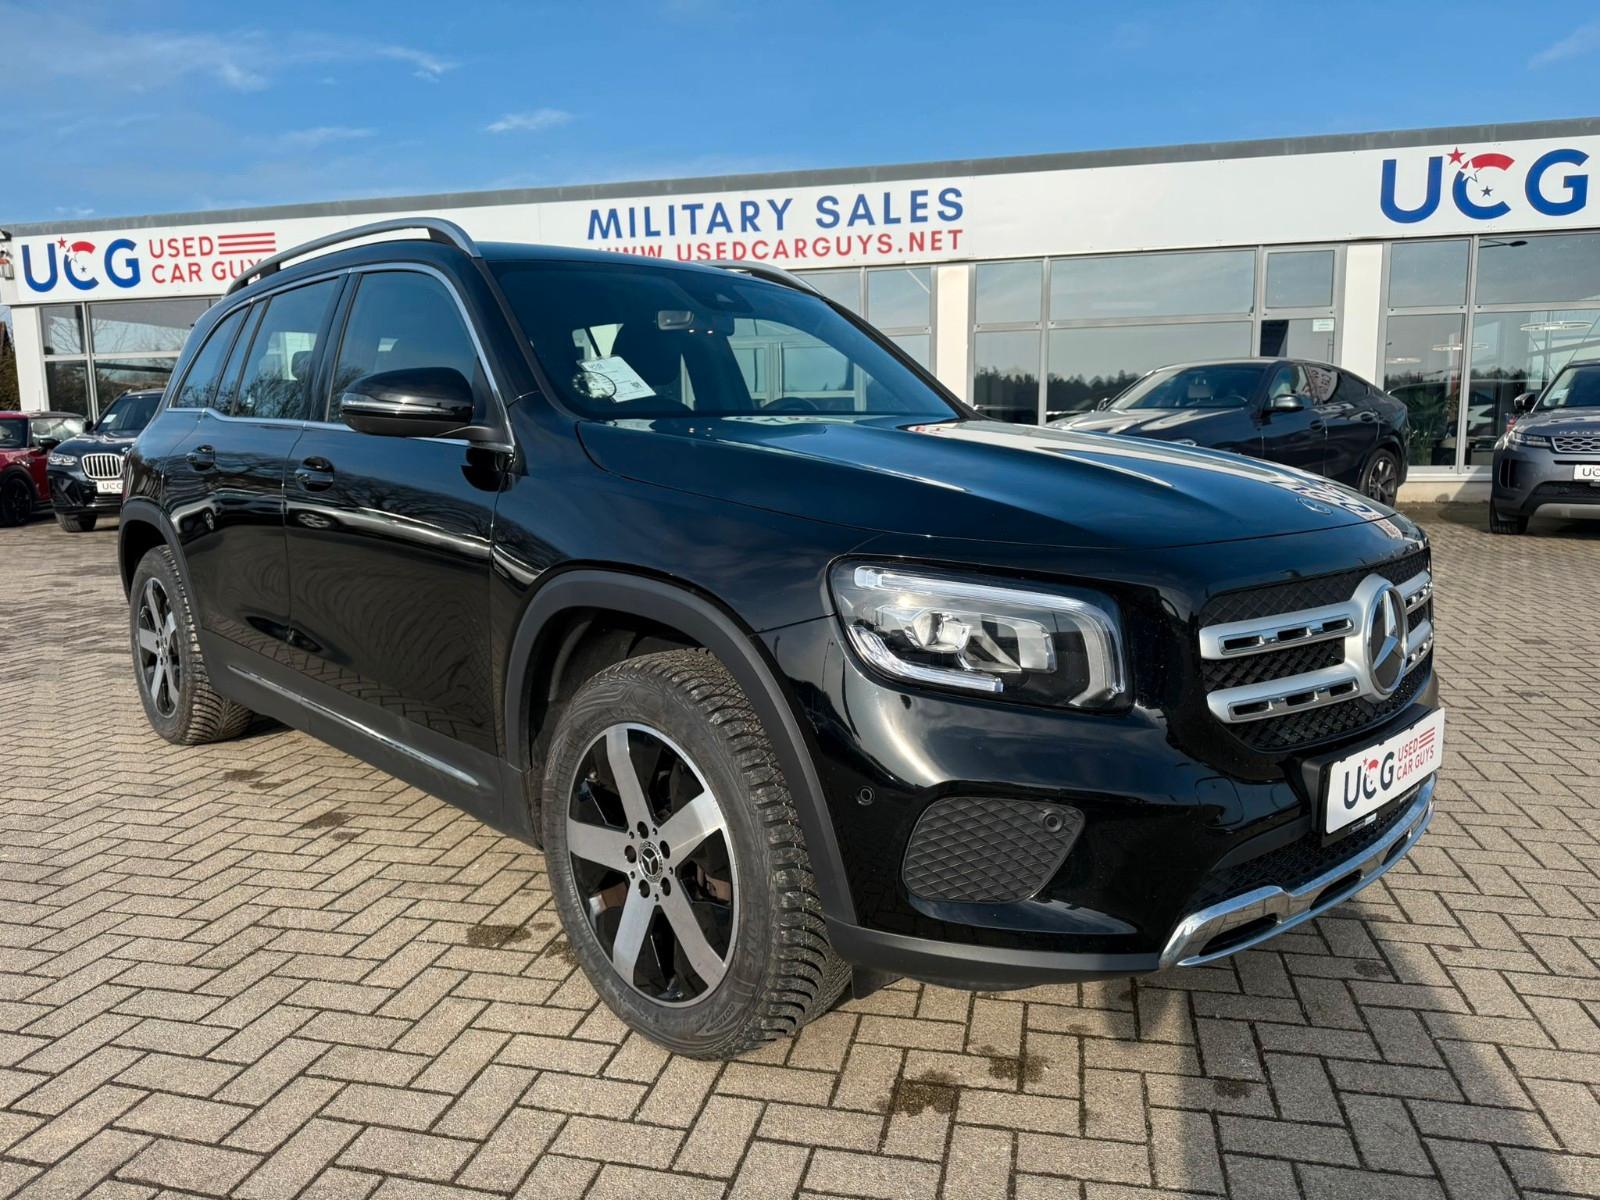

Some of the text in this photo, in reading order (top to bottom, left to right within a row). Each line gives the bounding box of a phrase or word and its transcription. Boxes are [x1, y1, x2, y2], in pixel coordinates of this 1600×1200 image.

[1380, 148, 1590, 224] UCG
[587, 187, 964, 240] MILITARY SALES
[21, 238, 142, 293] UCG
[148, 236, 215, 260] USED
[151, 262, 204, 285] CAR
[1396, 745, 1434, 780] CAR GUYS
[1398, 738, 1418, 761] USED
[1343, 751, 1395, 810] UCG
